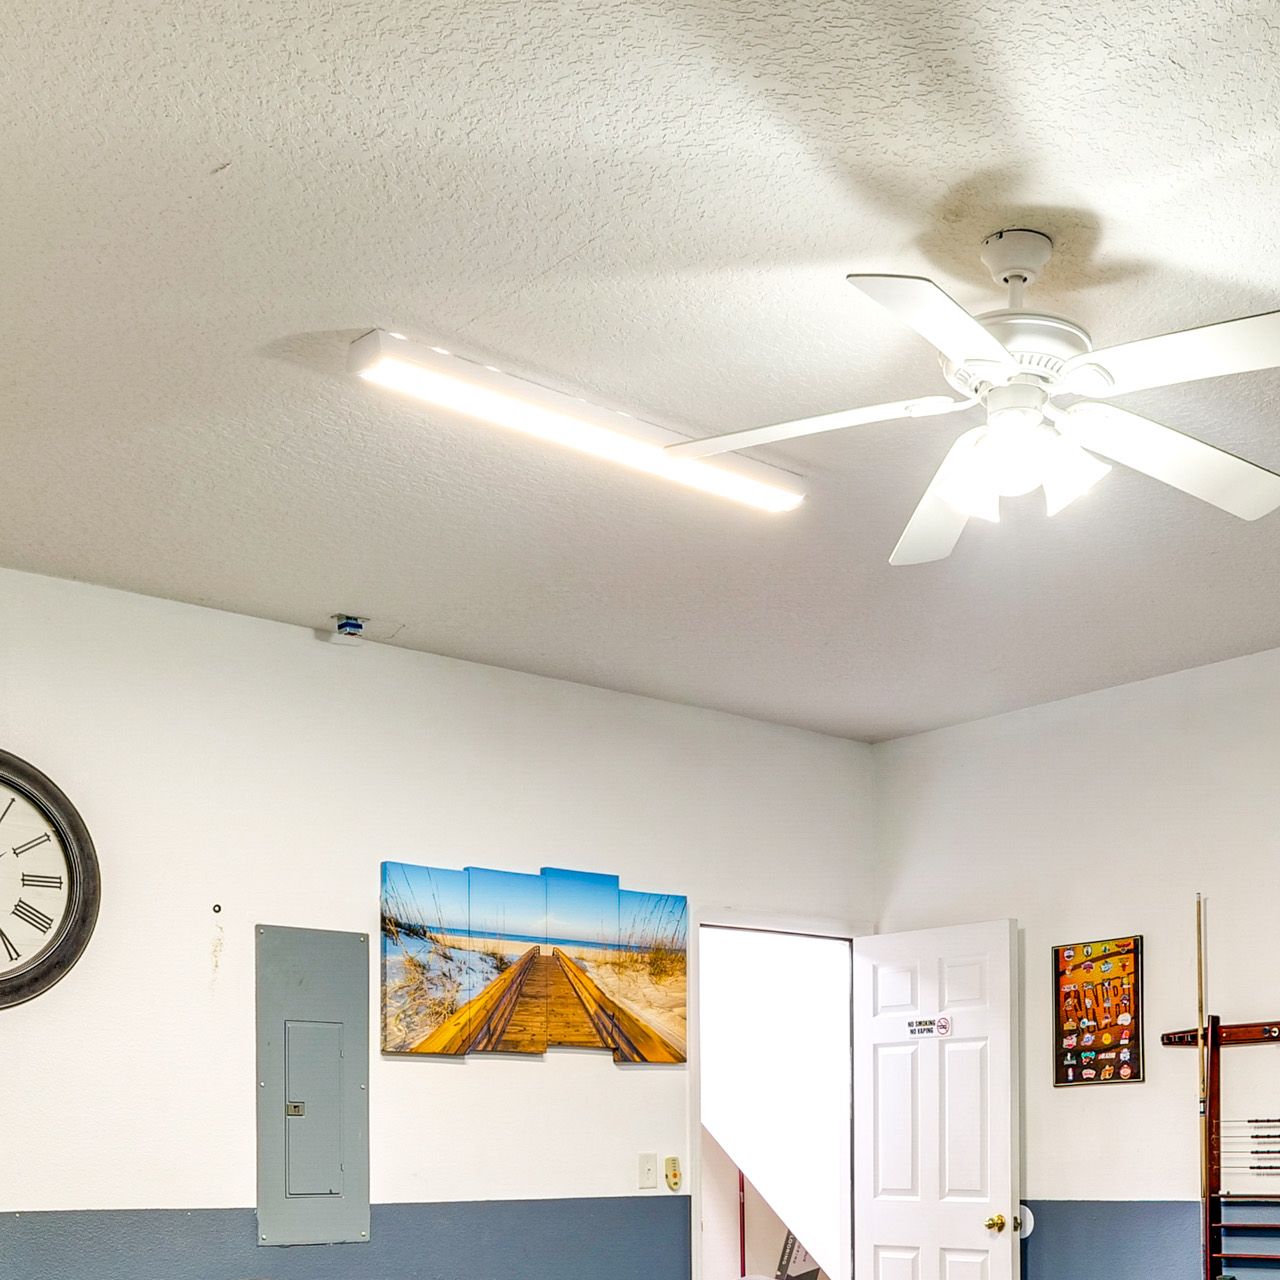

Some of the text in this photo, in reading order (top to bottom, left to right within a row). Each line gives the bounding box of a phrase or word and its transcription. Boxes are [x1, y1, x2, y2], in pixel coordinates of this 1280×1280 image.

[11, 831, 52, 858] II
[21, 871, 63, 890] III
[915, 1019, 936, 1027] SMOKING
